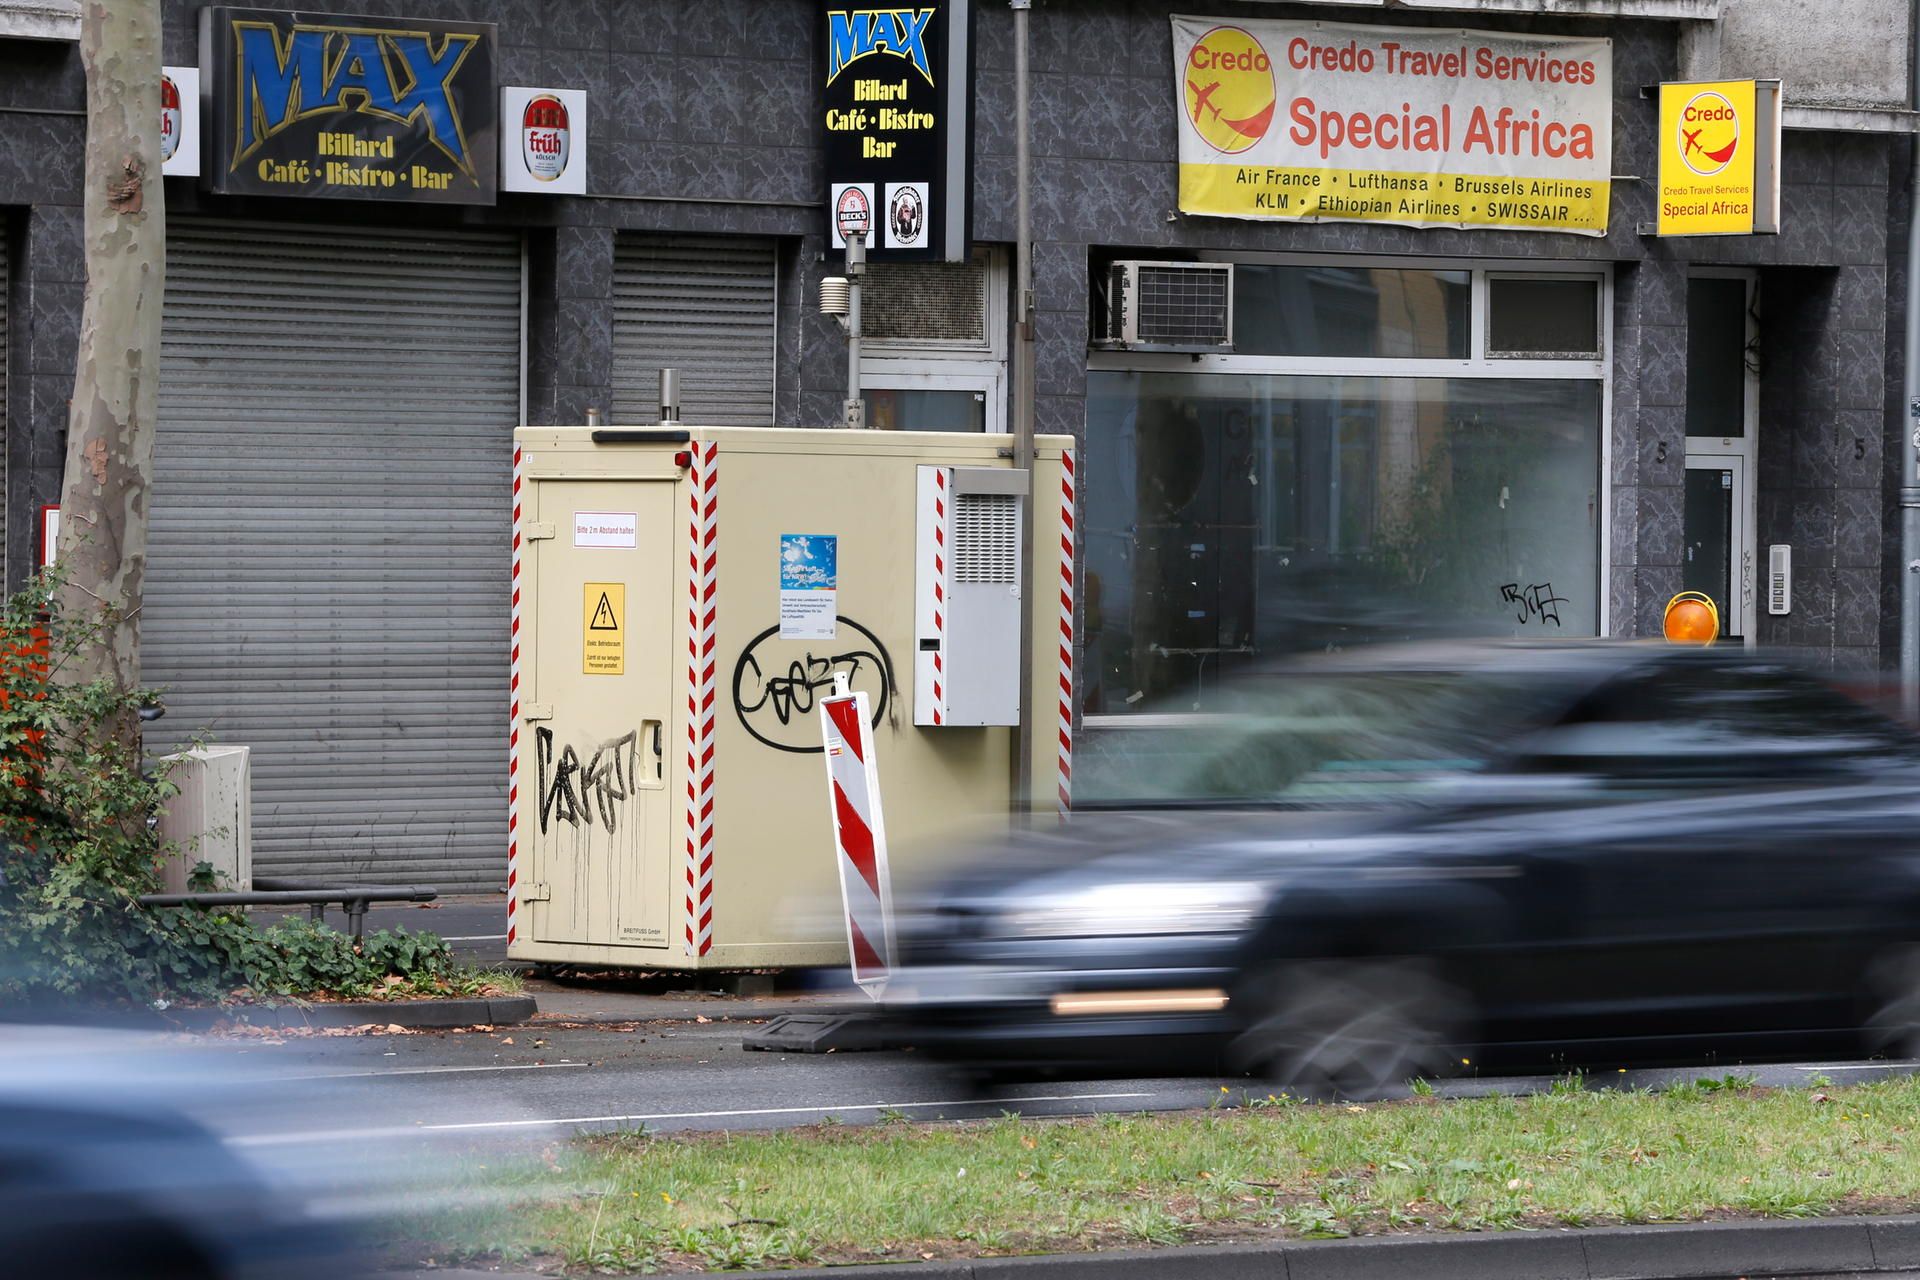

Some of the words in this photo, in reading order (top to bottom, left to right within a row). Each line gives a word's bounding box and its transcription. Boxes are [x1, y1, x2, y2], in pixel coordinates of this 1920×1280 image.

[826, 8, 936, 88] MAX
[1189, 45, 1271, 73] Credo
[1287, 37, 1374, 73] Credo
[1381, 42, 1467, 78] Travel
[1475, 47, 1596, 86] Services
[855, 79, 908, 101] Billard
[229, 20, 481, 188] MAX
[1684, 106, 1735, 121] Credo
[825, 107, 867, 131] Café
[878, 108, 935, 130] Bistro
[1289, 97, 1451, 160] Special
[1462, 105, 1595, 160] Africa
[318, 132, 394, 159] Billard
[529, 131, 561, 155] früh
[862, 136, 897, 158] Bar
[258, 158, 310, 184] Café
[326, 161, 396, 188] Bistro
[411, 165, 453, 190] Bar
[1236, 168, 1260, 184] Air
[1266, 170, 1321, 187] France
[1348, 172, 1429, 191] Lufthansa
[1454, 178, 1524, 196] Brussels
[1530, 180, 1592, 199] Airlines
[1663, 186, 1688, 196] Credo
[1689, 185, 1714, 195] Travel
[1715, 184, 1749, 195] Services
[1255, 192, 1289, 209] KLM
[1317, 195, 1393, 215] Ethiopian
[1398, 199, 1460, 216] Airlines
[1487, 203, 1569, 221] SWISSAIR
[1663, 201, 1709, 219] Special
[1711, 201, 1748, 215] Africa
[1656, 441, 1666, 463] 5
[1854, 438, 1865, 460] 5
